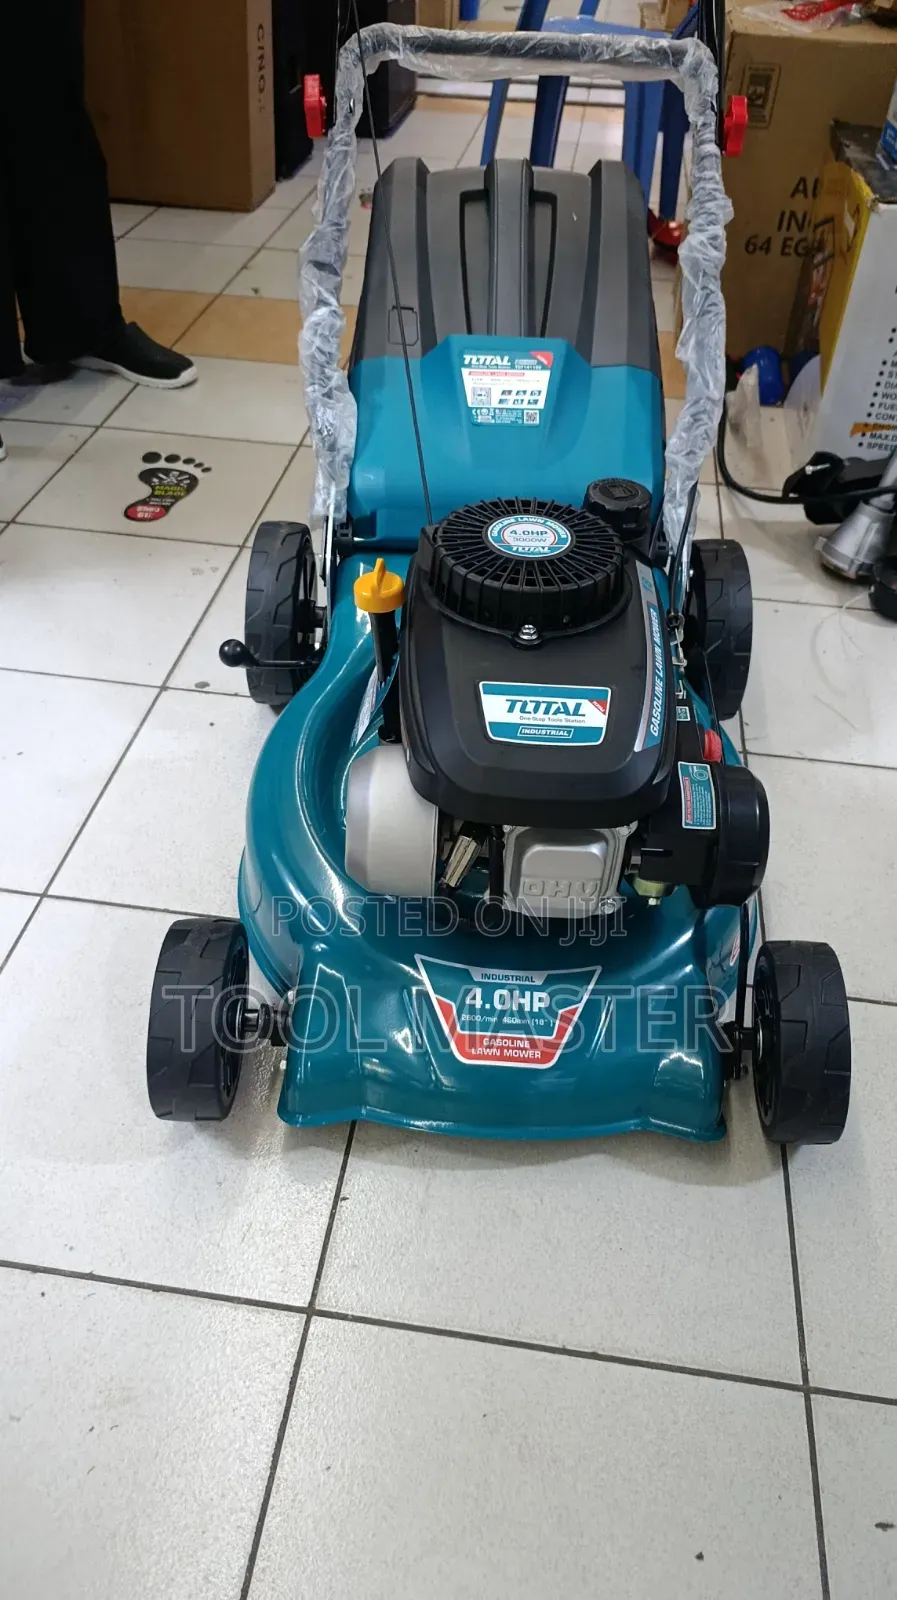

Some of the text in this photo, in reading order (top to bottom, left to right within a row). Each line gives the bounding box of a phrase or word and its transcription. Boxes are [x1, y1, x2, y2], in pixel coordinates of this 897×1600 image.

[744, 234, 773, 256] 64
[463, 354, 511, 366] TOTAL
[878, 402, 897, 411] FUE
[875, 412, 897, 421] CON
[491, 516, 568, 539] GASOLINE LAWN MOWER
[509, 529, 548, 537] 4.0HP
[650, 607, 664, 737] GASOLINE LAWN MOWER
[505, 698, 586, 717] TOTAL
[521, 728, 570, 737] INDUSTRIAL
[523, 880, 599, 898] OHV
[480, 972, 536, 983] INDUSTRIAL
[465, 987, 550, 1012] 4.0HP
[483, 1037, 531, 1049] GASOLINE
[471, 1047, 541, 1059] LAWN MOWER
